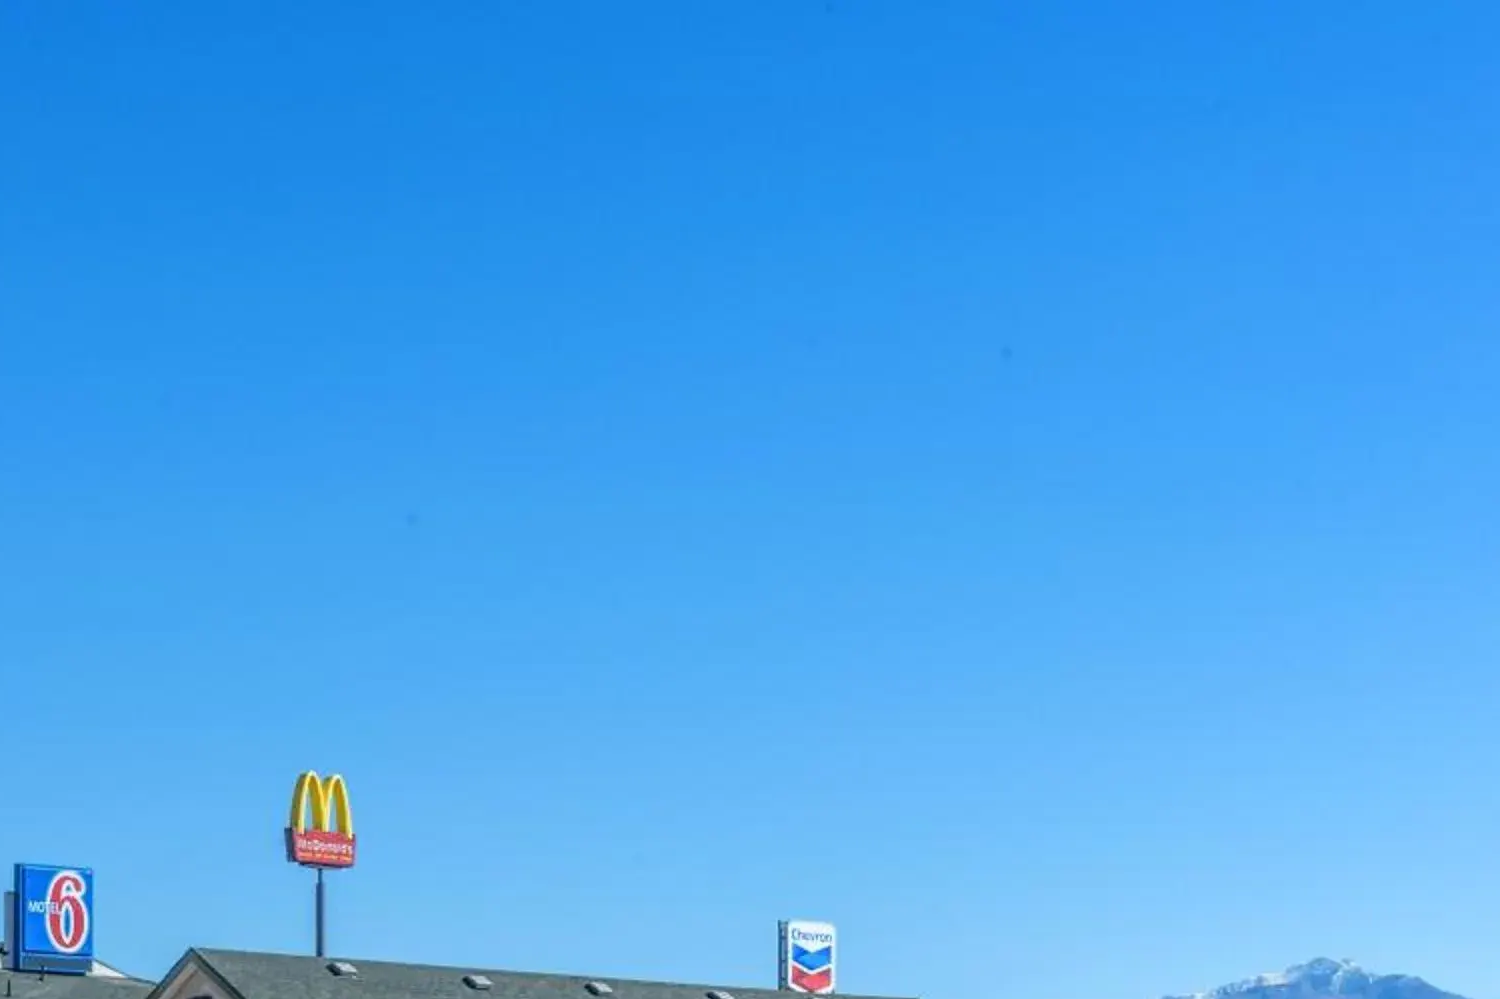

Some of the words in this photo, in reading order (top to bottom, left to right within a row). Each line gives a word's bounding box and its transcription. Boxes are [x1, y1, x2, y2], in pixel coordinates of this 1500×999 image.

[27, 900, 61, 915] MOTEL
[45, 870, 88, 954] 6
[791, 927, 833, 943] Chevron
